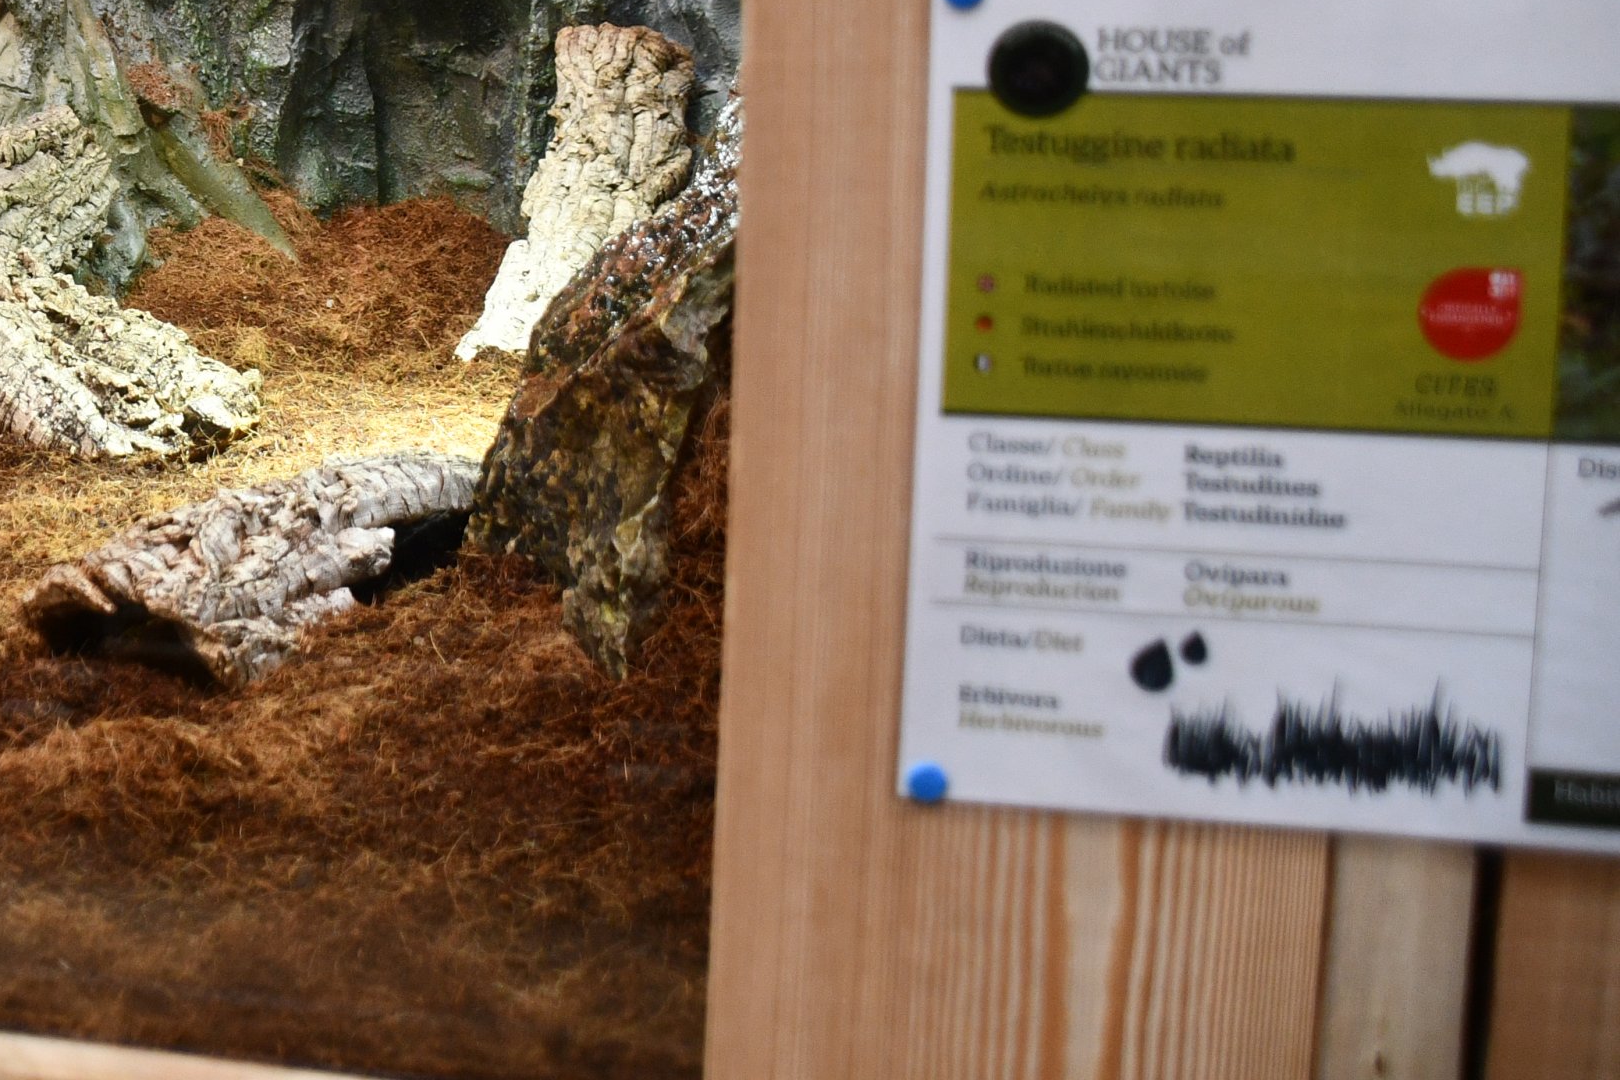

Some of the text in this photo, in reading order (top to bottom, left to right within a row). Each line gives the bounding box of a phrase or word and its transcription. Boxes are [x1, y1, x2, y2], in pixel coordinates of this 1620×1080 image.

[1097, 27, 1250, 56] HOUSE of
[1094, 57, 1221, 83] GIANTS
[985, 125, 1297, 163] Testuggine radiata
[968, 432, 1285, 471] Classe/ Class Reptilia
[967, 462, 1322, 498] Ordine/ Order Testudines
[1578, 457, 1620, 478] Dis
[967, 492, 1083, 519] Famiglia/
[1088, 497, 1173, 523] Family
[965, 550, 1289, 588] Riproduzione Ovipara
[963, 576, 1121, 604] Reproduction
